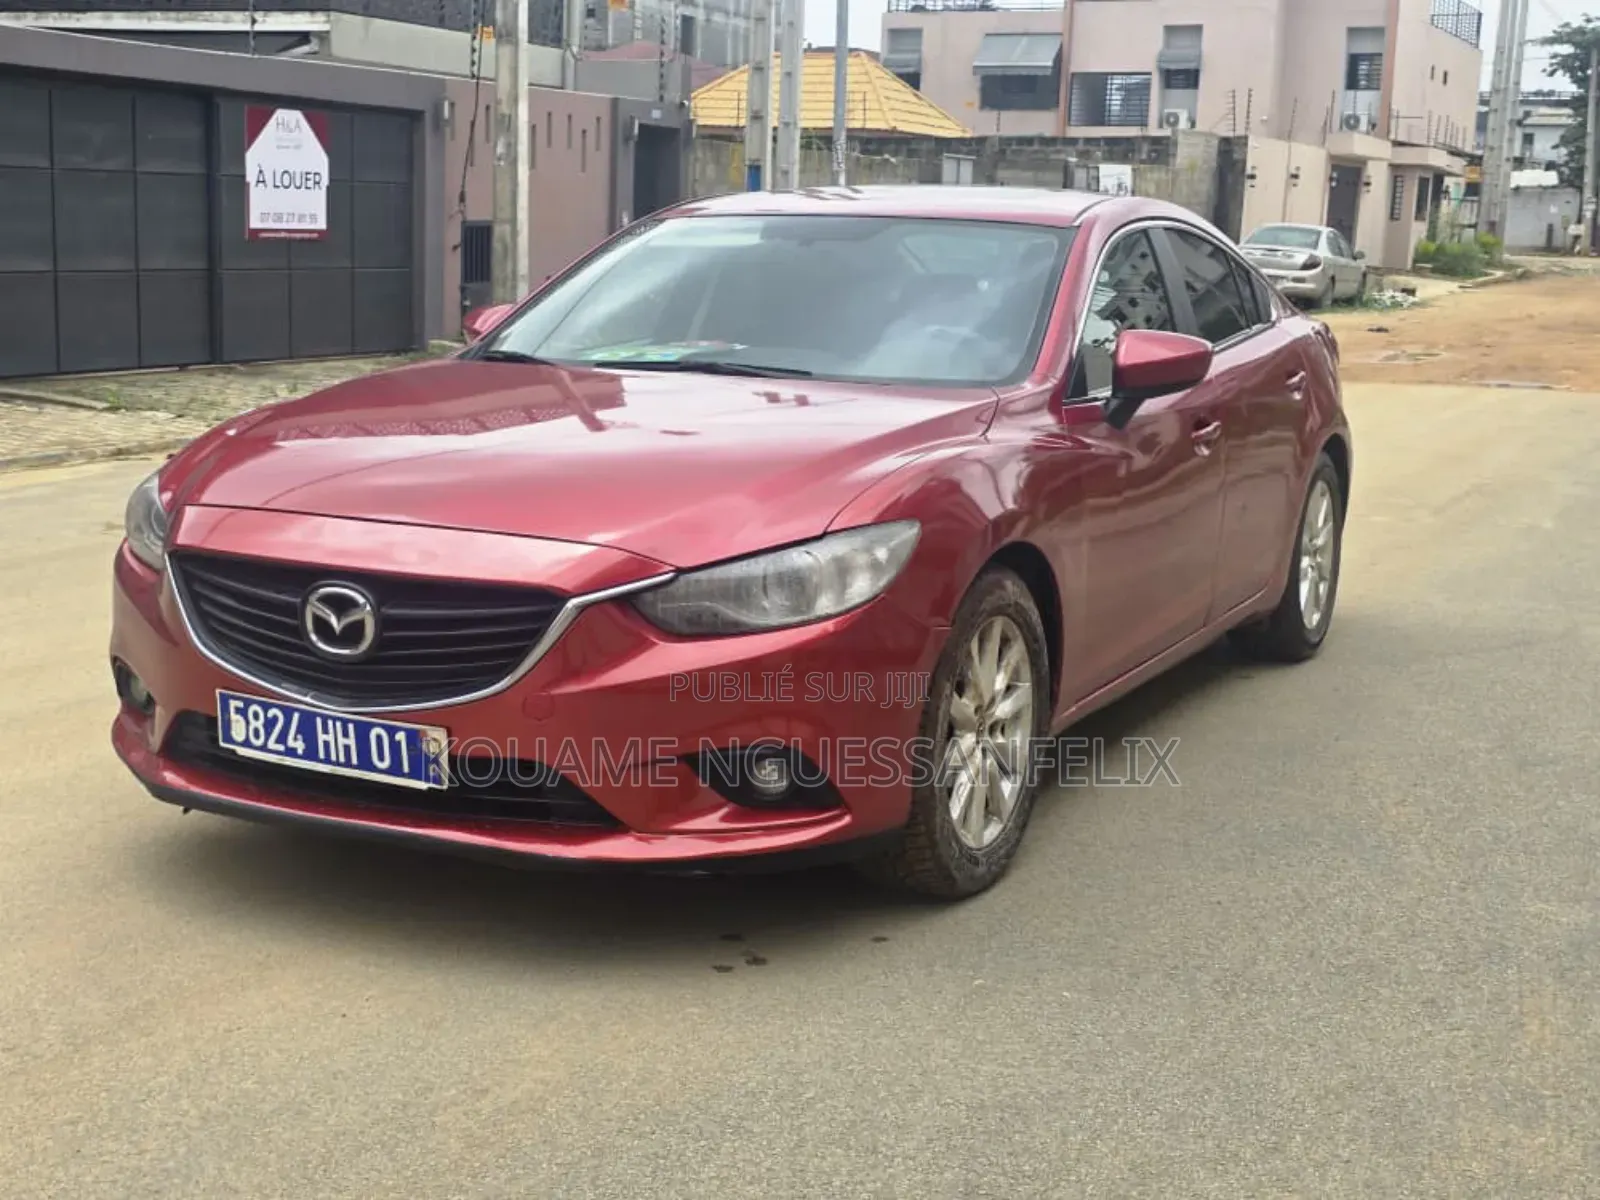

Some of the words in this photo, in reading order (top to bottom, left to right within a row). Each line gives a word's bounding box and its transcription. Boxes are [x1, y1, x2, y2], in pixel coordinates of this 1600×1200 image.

[255, 163, 267, 188] À
[272, 168, 322, 190] LOUER
[228, 699, 305, 755] 5824
[316, 716, 358, 765] HH
[369, 726, 410, 773] 01
